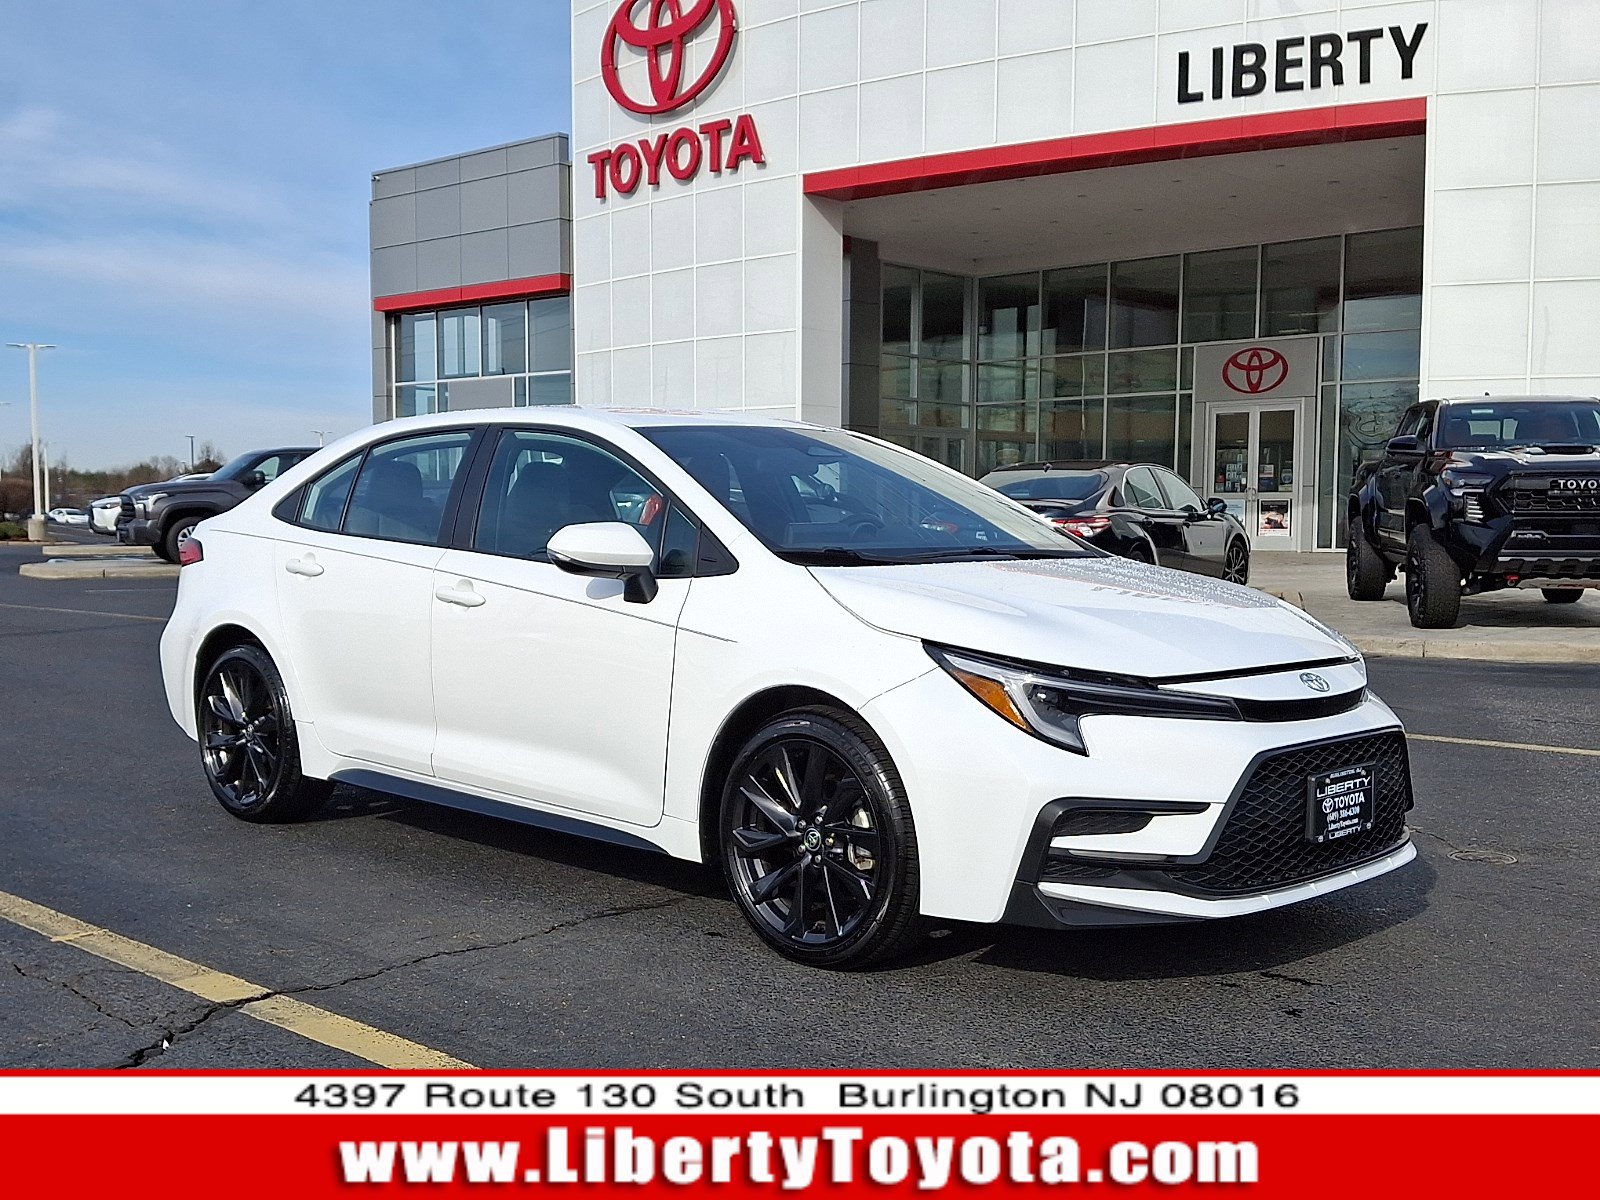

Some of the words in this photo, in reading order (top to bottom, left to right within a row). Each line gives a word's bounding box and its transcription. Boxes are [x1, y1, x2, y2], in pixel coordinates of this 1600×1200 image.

[1177, 22, 1429, 104] LIBERTY
[587, 114, 765, 199] TOYOTA
[1557, 479, 1600, 490] TOYO
[1316, 776, 1371, 798] LIBERTY
[1333, 791, 1365, 810] TOYOTA
[1329, 825, 1361, 839] LIBERTY
